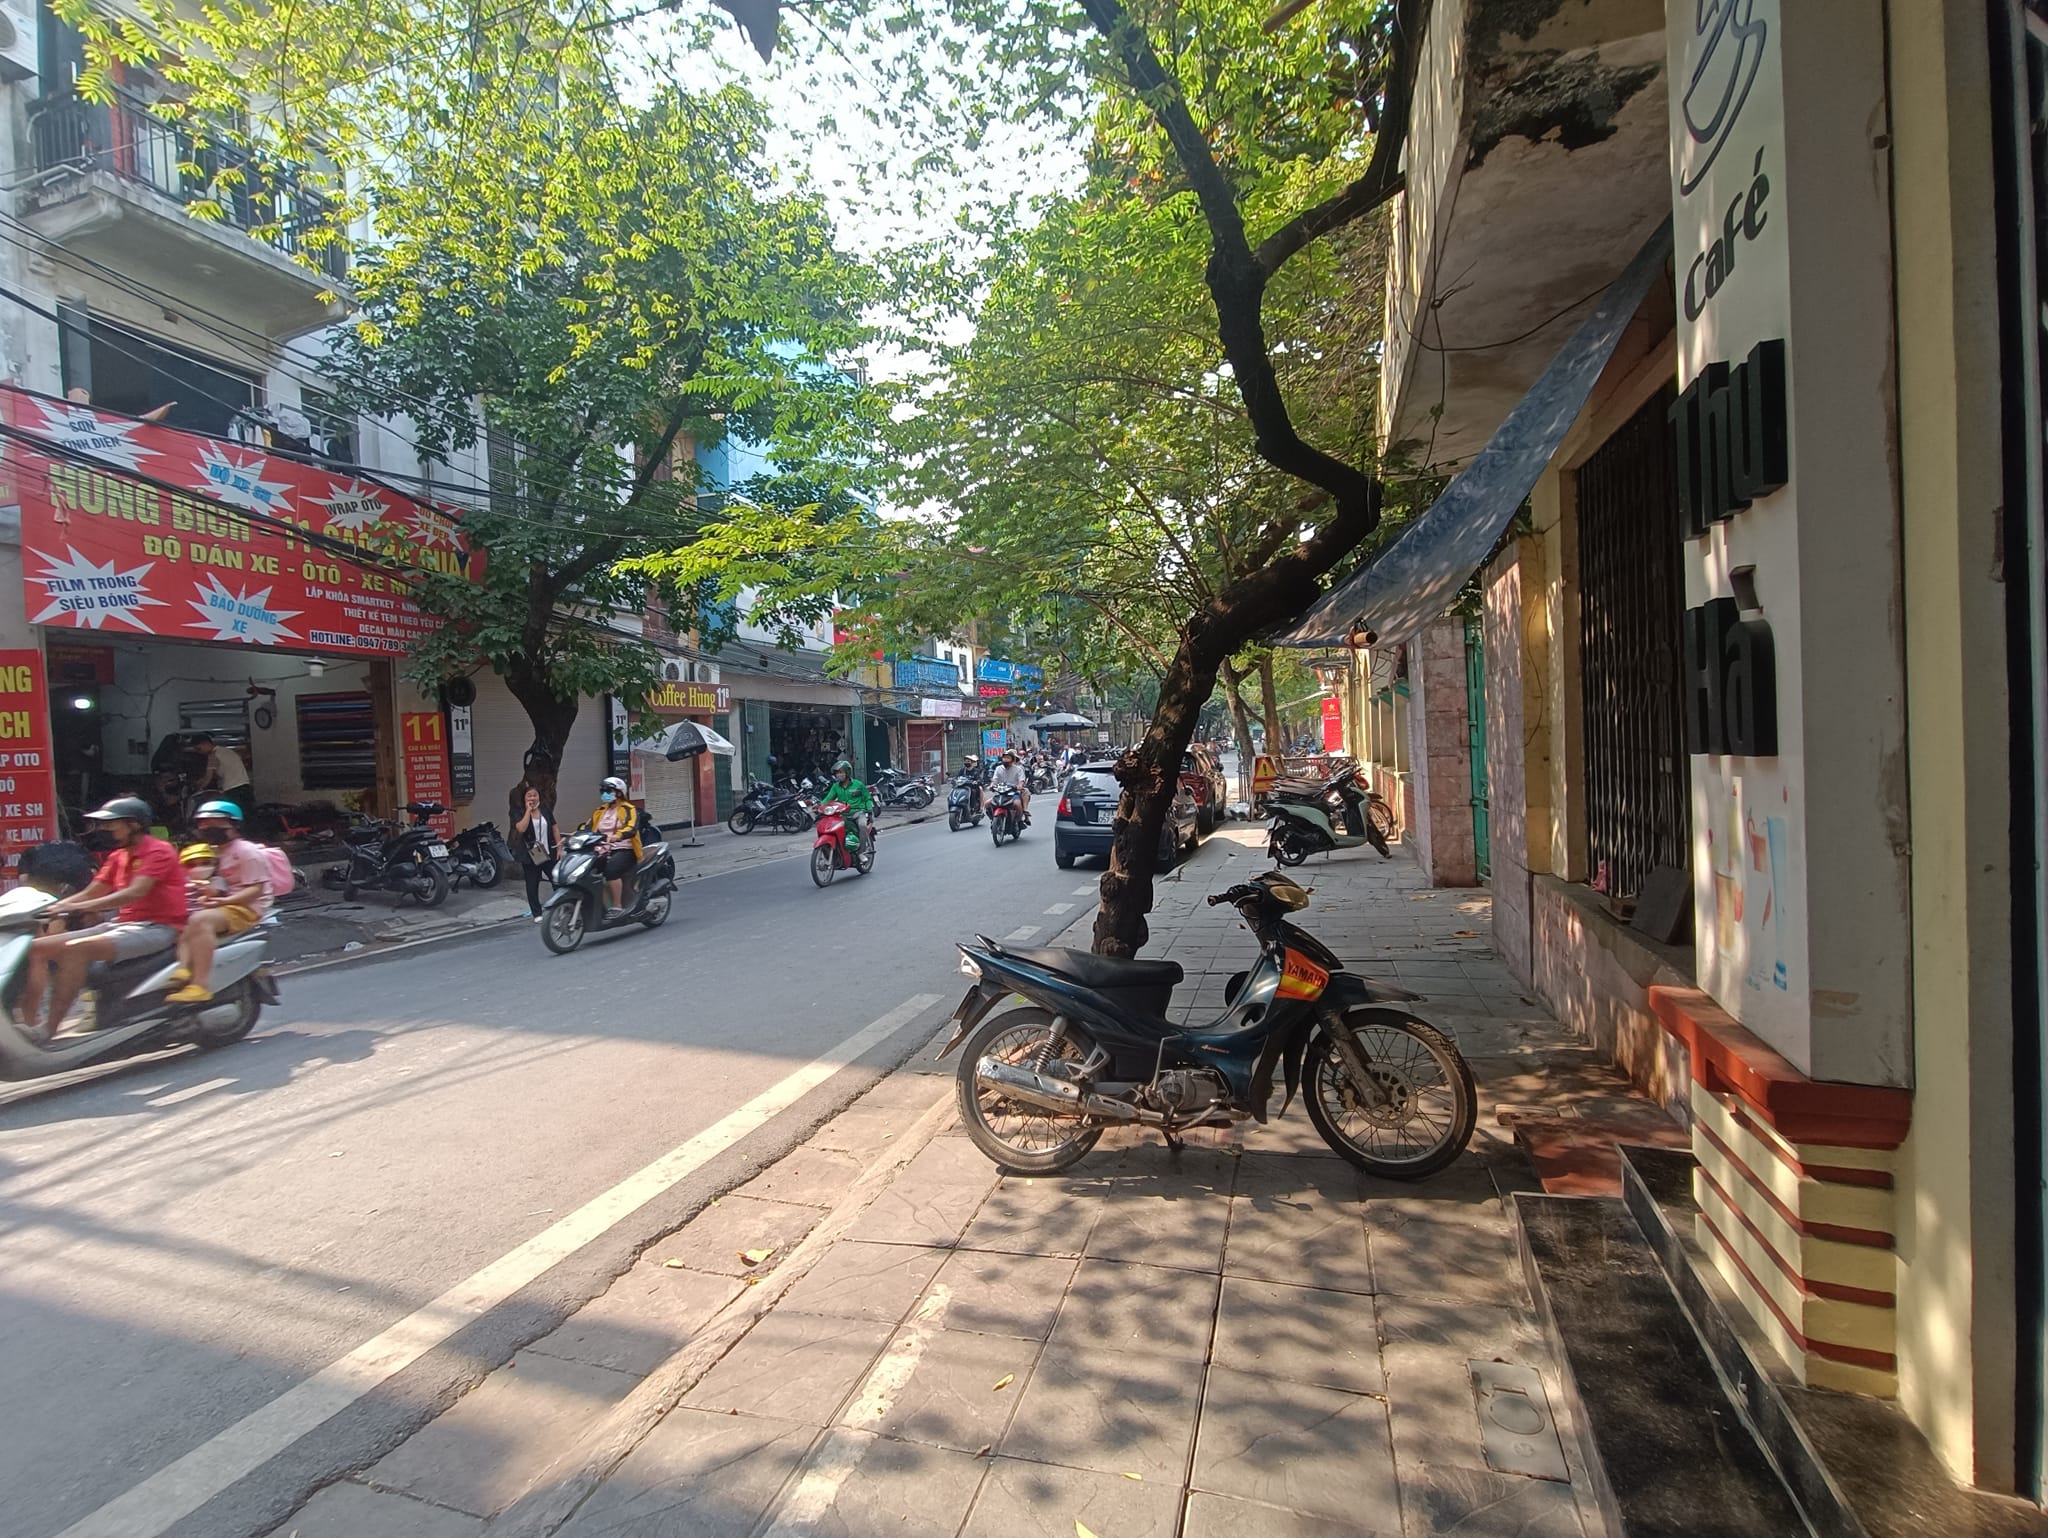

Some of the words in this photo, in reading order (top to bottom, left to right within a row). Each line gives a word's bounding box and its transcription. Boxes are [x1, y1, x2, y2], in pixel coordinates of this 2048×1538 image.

[1684, 146, 1770, 323] Café
[1668, 338, 1789, 541] Thu
[50, 463, 160, 526] HÙNG
[325, 500, 358, 516] WRAP
[143, 534, 181, 563] ĐỘ
[190, 542, 243, 570] DÁN
[251, 554, 279, 575] XE
[302, 560, 341, 585] ÔTÔ
[361, 573, 384, 593] XE
[48, 578, 85, 593] FILM
[88, 575, 137, 591] TRONG
[59, 594, 95, 612] SIÊU
[99, 592, 138, 609] BÓNG
[231, 619, 248, 634] XE
[310, 630, 355, 646] HOTLINE:
[357, 637, 379, 649] 0947
[359, 623, 385, 636] DECAL
[1682, 564, 1779, 757] Hà
[688, 685, 716, 714] Hùng
[406, 715, 440, 742] 11
[5, 803, 22, 817] XE
[25, 803, 44, 817] SH
[1288, 962, 1327, 989] YAMAHA
